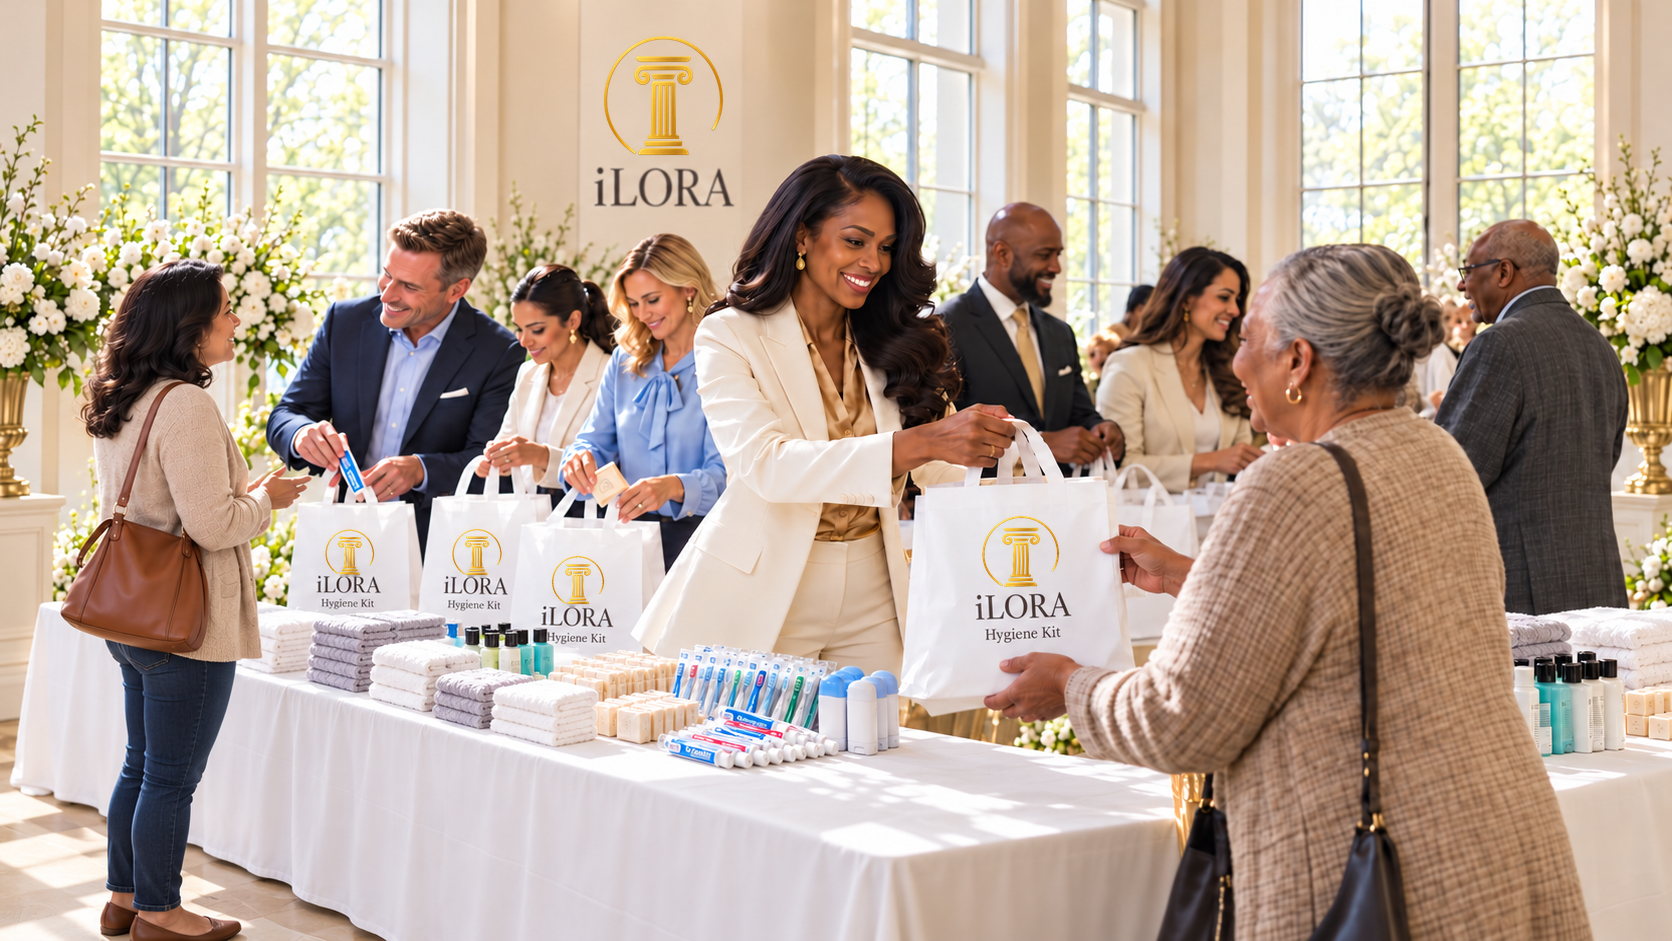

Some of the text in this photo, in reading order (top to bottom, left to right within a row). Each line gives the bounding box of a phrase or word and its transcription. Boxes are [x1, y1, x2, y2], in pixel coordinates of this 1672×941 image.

[594, 167, 734, 207] iLORA
[317, 575, 381, 593] iLORA
[444, 576, 508, 595] iLORA
[321, 598, 374, 610] Hygiene Kit
[447, 600, 501, 611] Hygiene Kit
[976, 592, 1072, 620] iLORA
[541, 606, 613, 628] iLORA
[547, 632, 606, 644] Hygiene Kit
[985, 626, 1061, 643] Hygiene Kit
